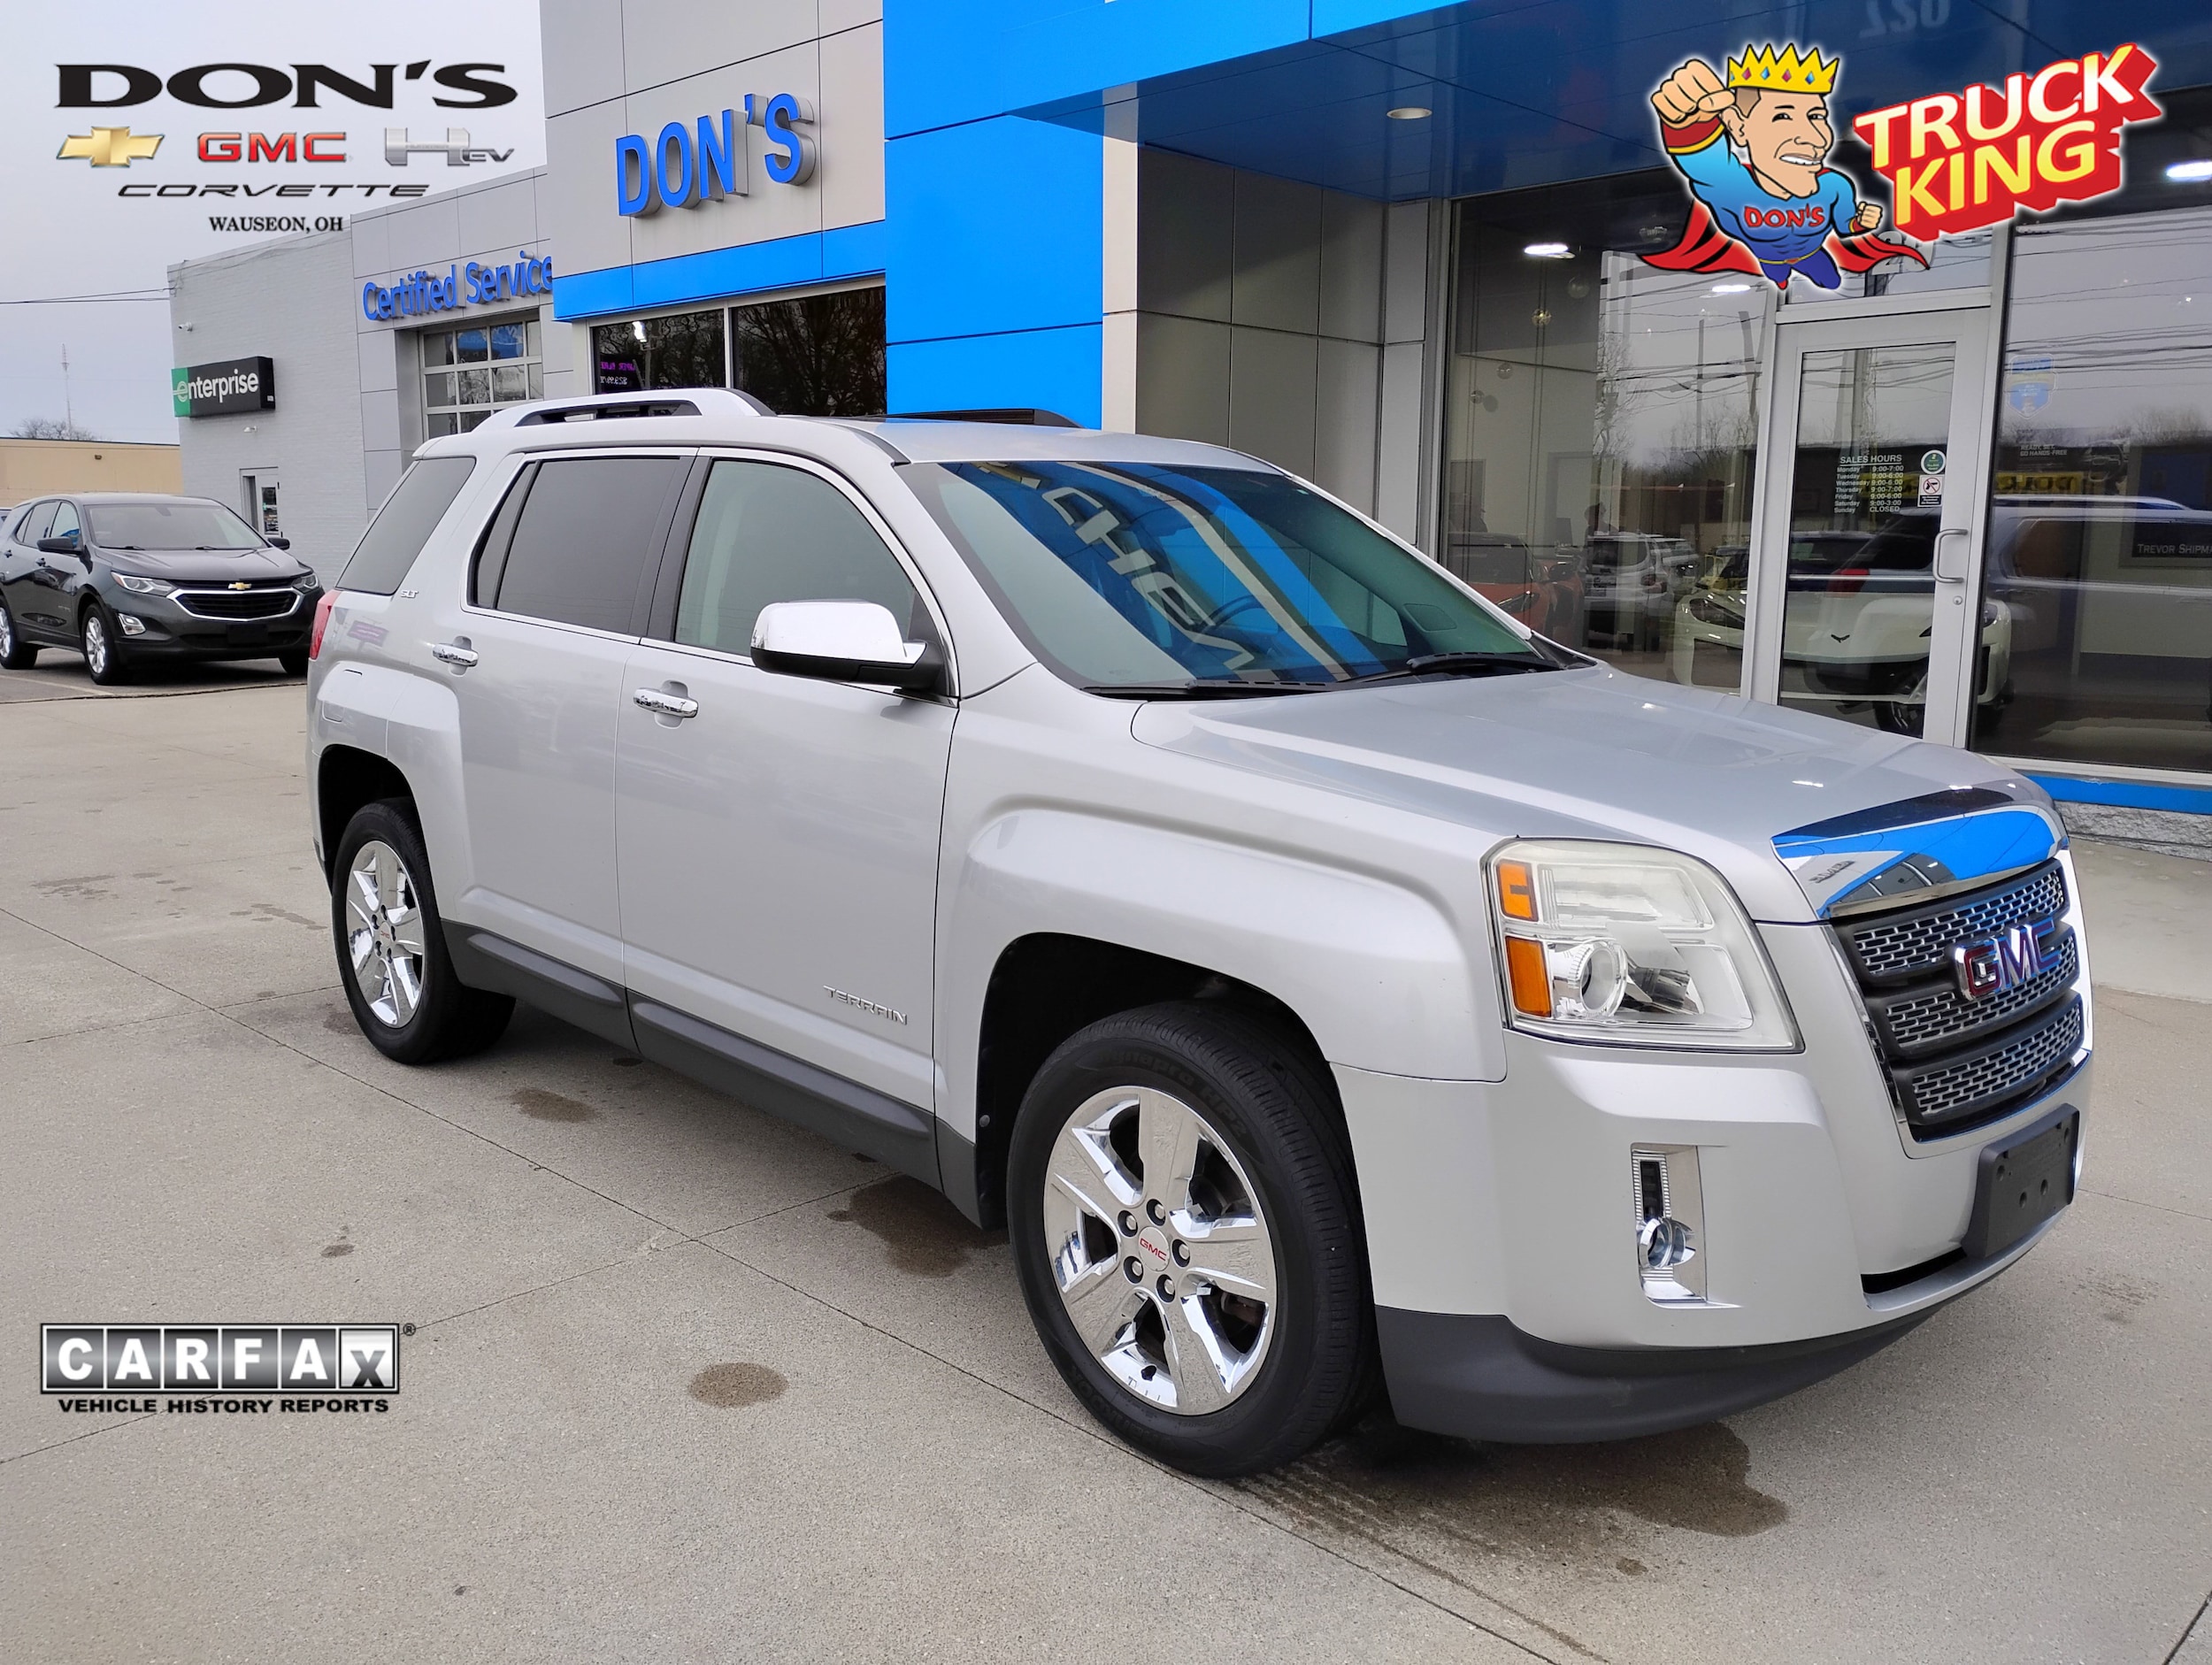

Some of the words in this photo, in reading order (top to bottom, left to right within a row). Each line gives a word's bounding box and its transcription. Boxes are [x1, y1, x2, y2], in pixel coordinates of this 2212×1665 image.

[616, 93, 803, 217] DON'S
[362, 264, 458, 321] Certified
[465, 249, 552, 303] Service
[173, 368, 258, 403] enterprise
[1870, 454, 1902, 463] HOURS
[2137, 543, 2177, 555] TREVOR
[1955, 917, 2062, 1001] GMC
[823, 984, 908, 1026] TERRAIN
[1139, 1238, 1167, 1262] GMC
